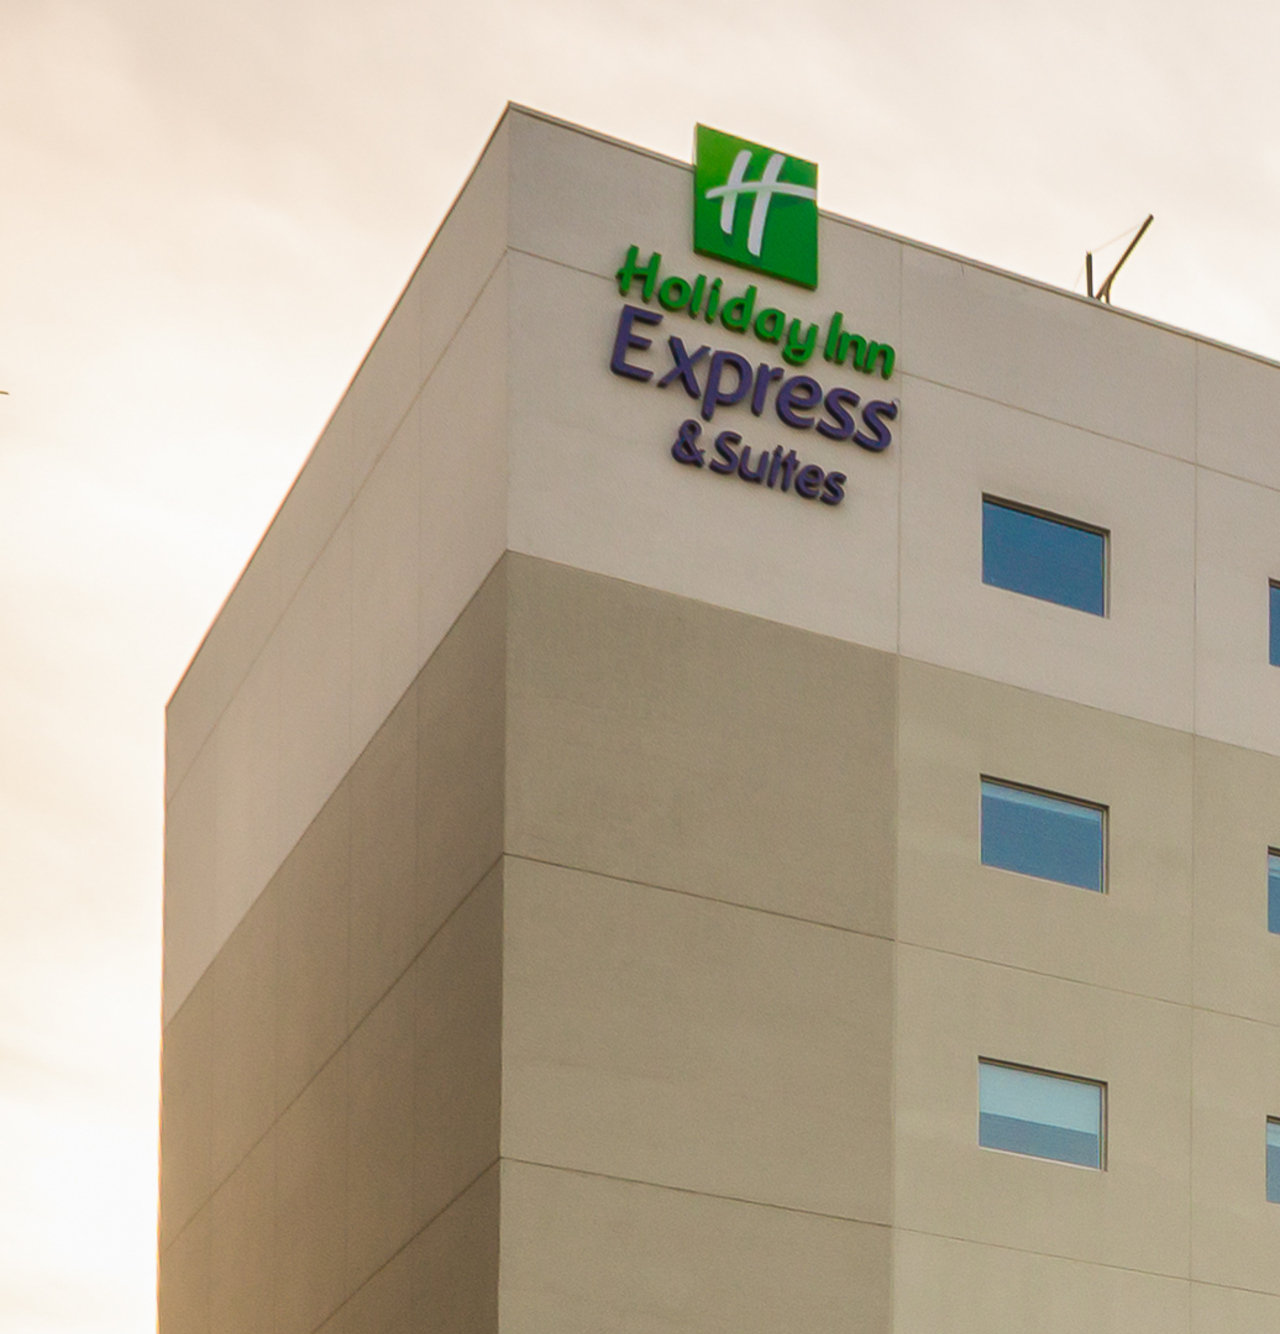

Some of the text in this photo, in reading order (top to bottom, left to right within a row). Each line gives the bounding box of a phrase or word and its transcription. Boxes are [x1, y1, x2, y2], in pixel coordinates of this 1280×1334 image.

[610, 303, 899, 453] Express
[615, 244, 897, 380] Holiday Inn
[671, 419, 848, 505] & Suites
